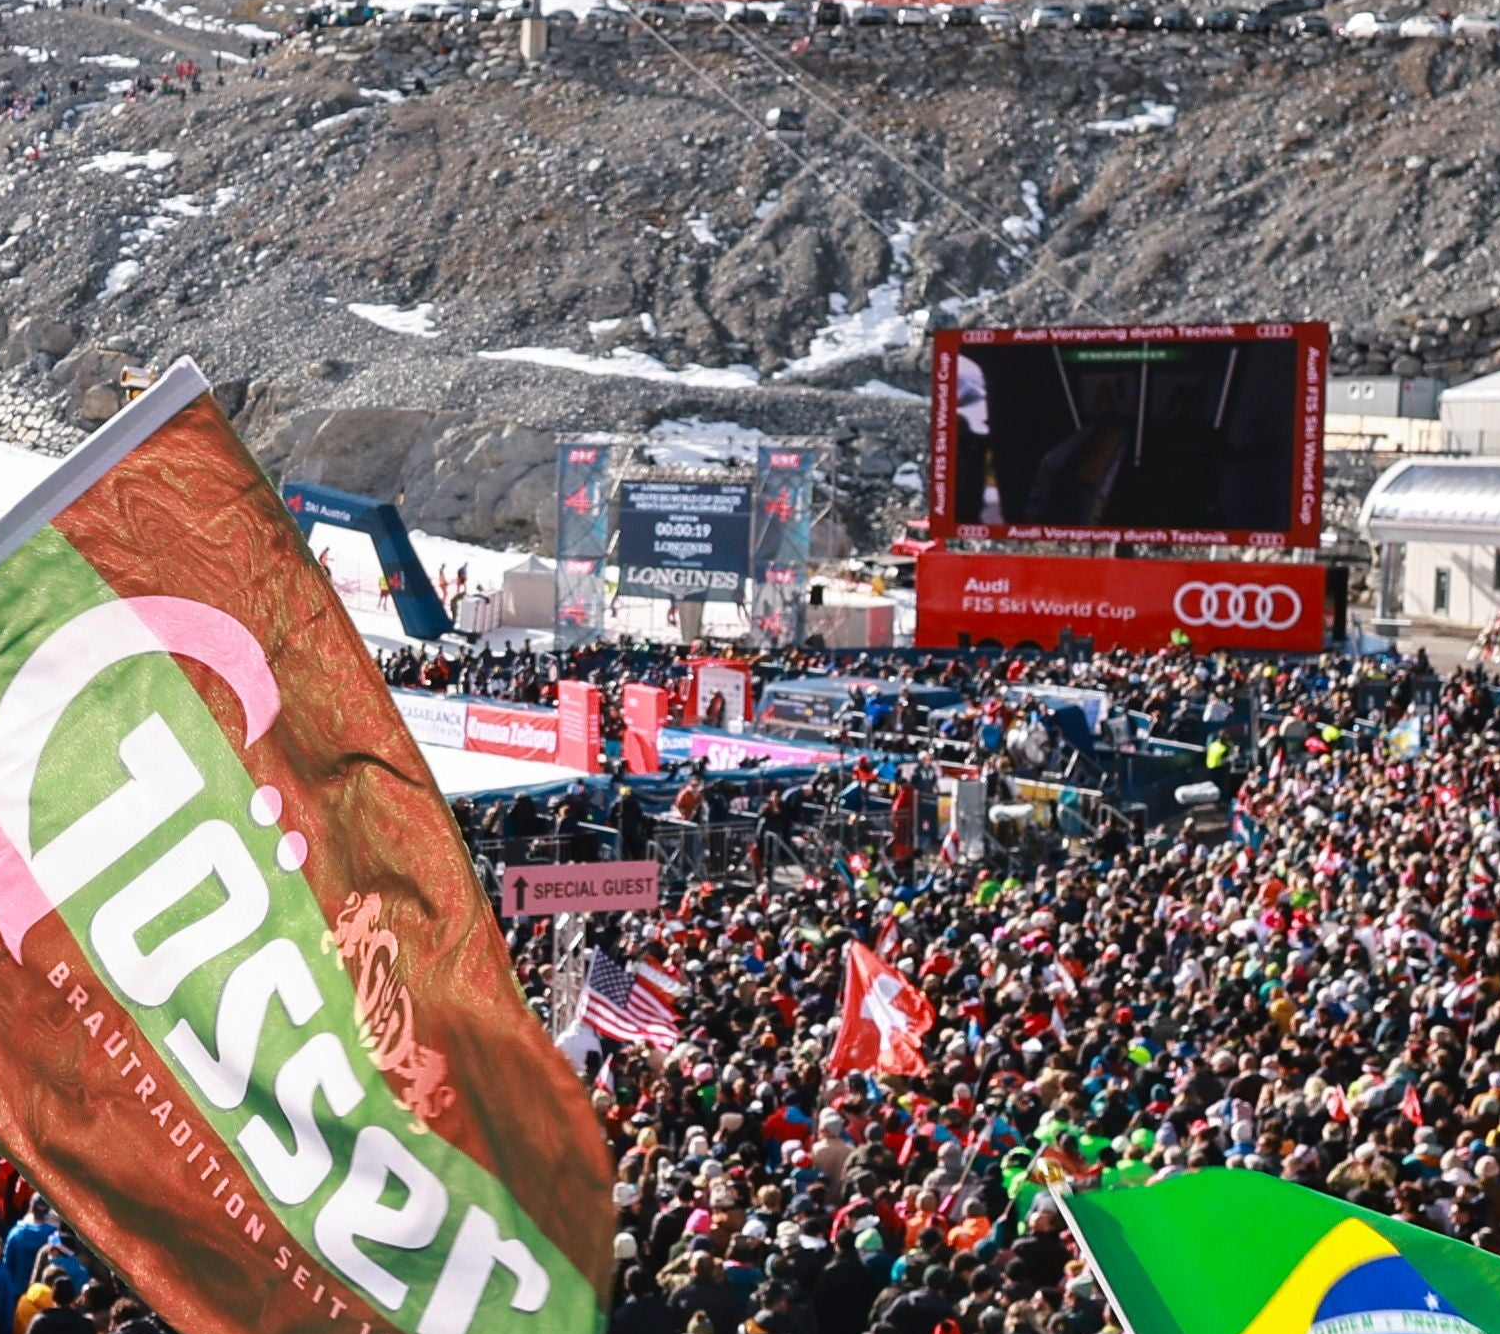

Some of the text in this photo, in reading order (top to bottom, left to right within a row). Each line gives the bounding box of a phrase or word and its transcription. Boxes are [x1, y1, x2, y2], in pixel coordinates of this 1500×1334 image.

[1013, 325, 1235, 341] Audi Vorsprung durch Technik
[937, 351, 951, 382] Cup
[1306, 346, 1320, 384] Audi
[936, 383, 949, 429] World
[1302, 441, 1317, 491] World
[304, 500, 319, 514] Ski
[934, 482, 946, 516] Audi
[1300, 493, 1316, 525] Cup
[1008, 526, 1228, 543] Audi Vorsprung durch Technik
[627, 566, 739, 590] LONGINES
[964, 577, 1010, 593] Audi
[962, 597, 1137, 620] FIS Ski World Cup
[533, 876, 653, 900] SPECIAL GUEST
[46, 961, 267, 1244] BRAUTRADITION
[273, 1245, 348, 1320] SEIT
